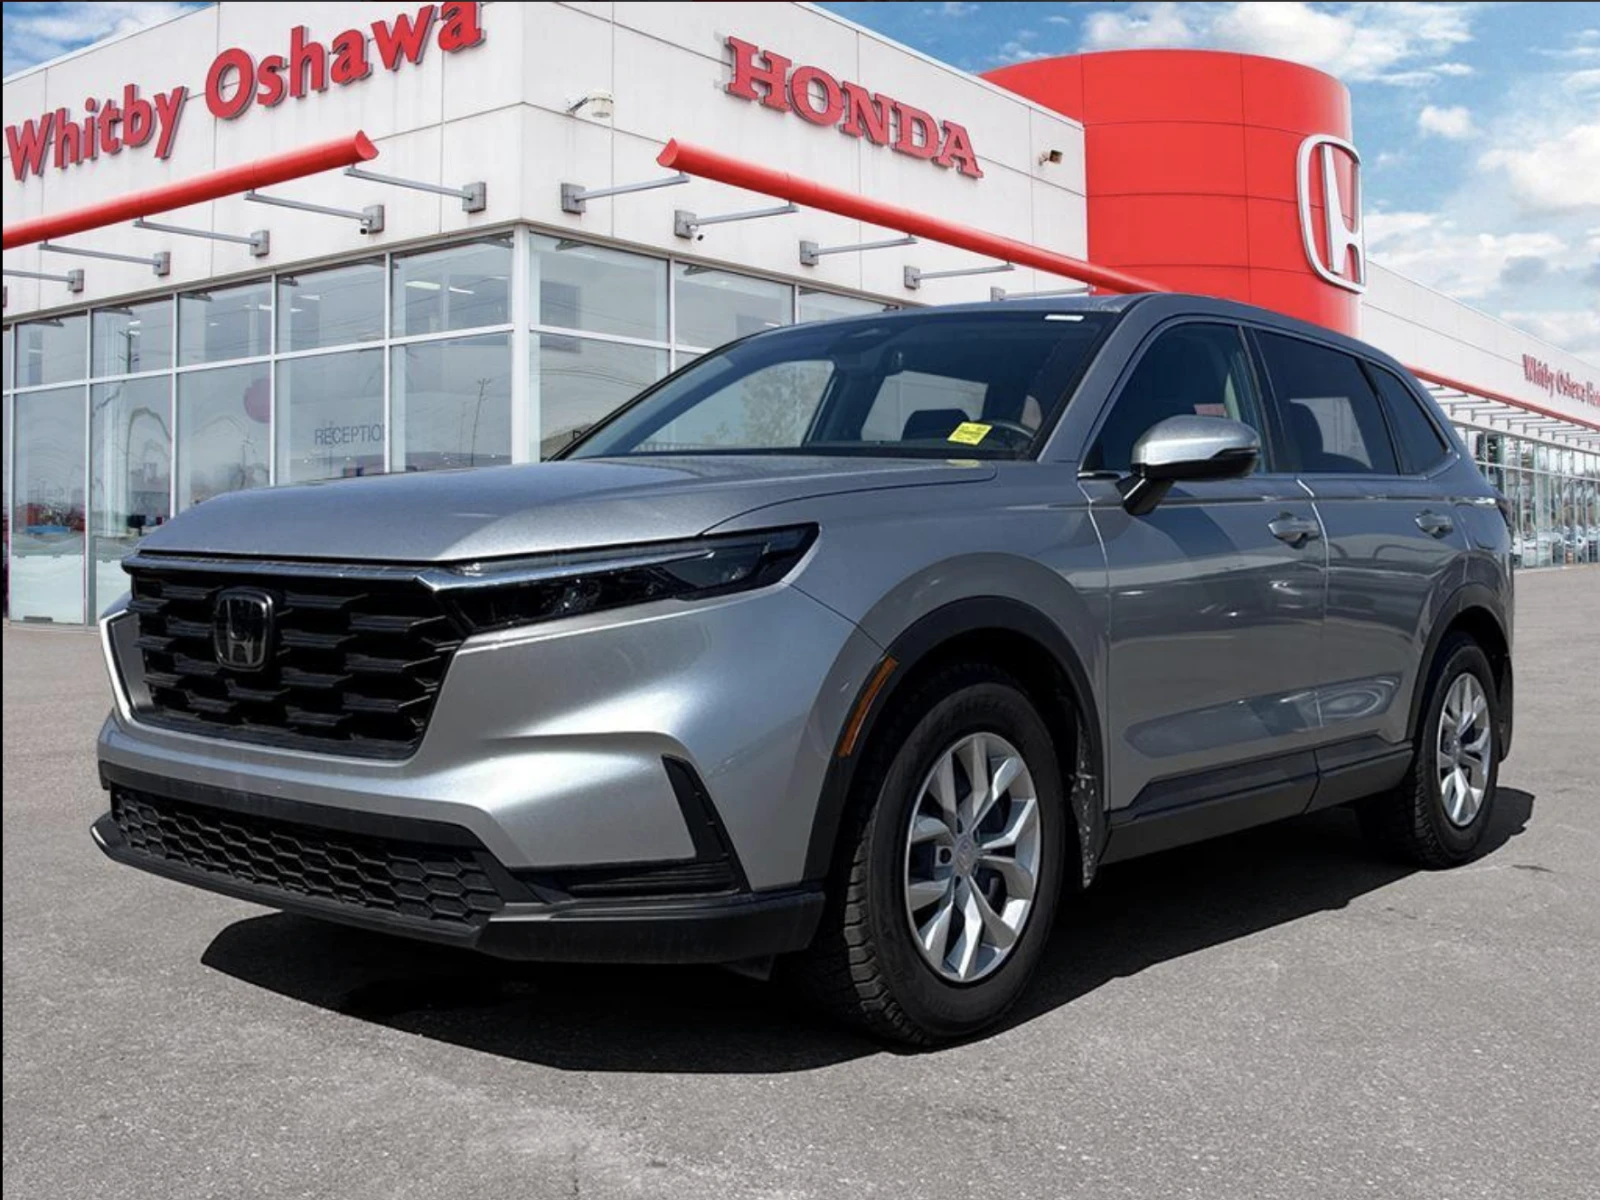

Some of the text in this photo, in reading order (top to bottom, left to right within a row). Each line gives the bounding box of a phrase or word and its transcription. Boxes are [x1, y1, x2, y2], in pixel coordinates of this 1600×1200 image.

[5, 2, 487, 182] Whitby Oshawa
[725, 35, 984, 179] HONDA
[314, 424, 385, 446] RECEPTIO
